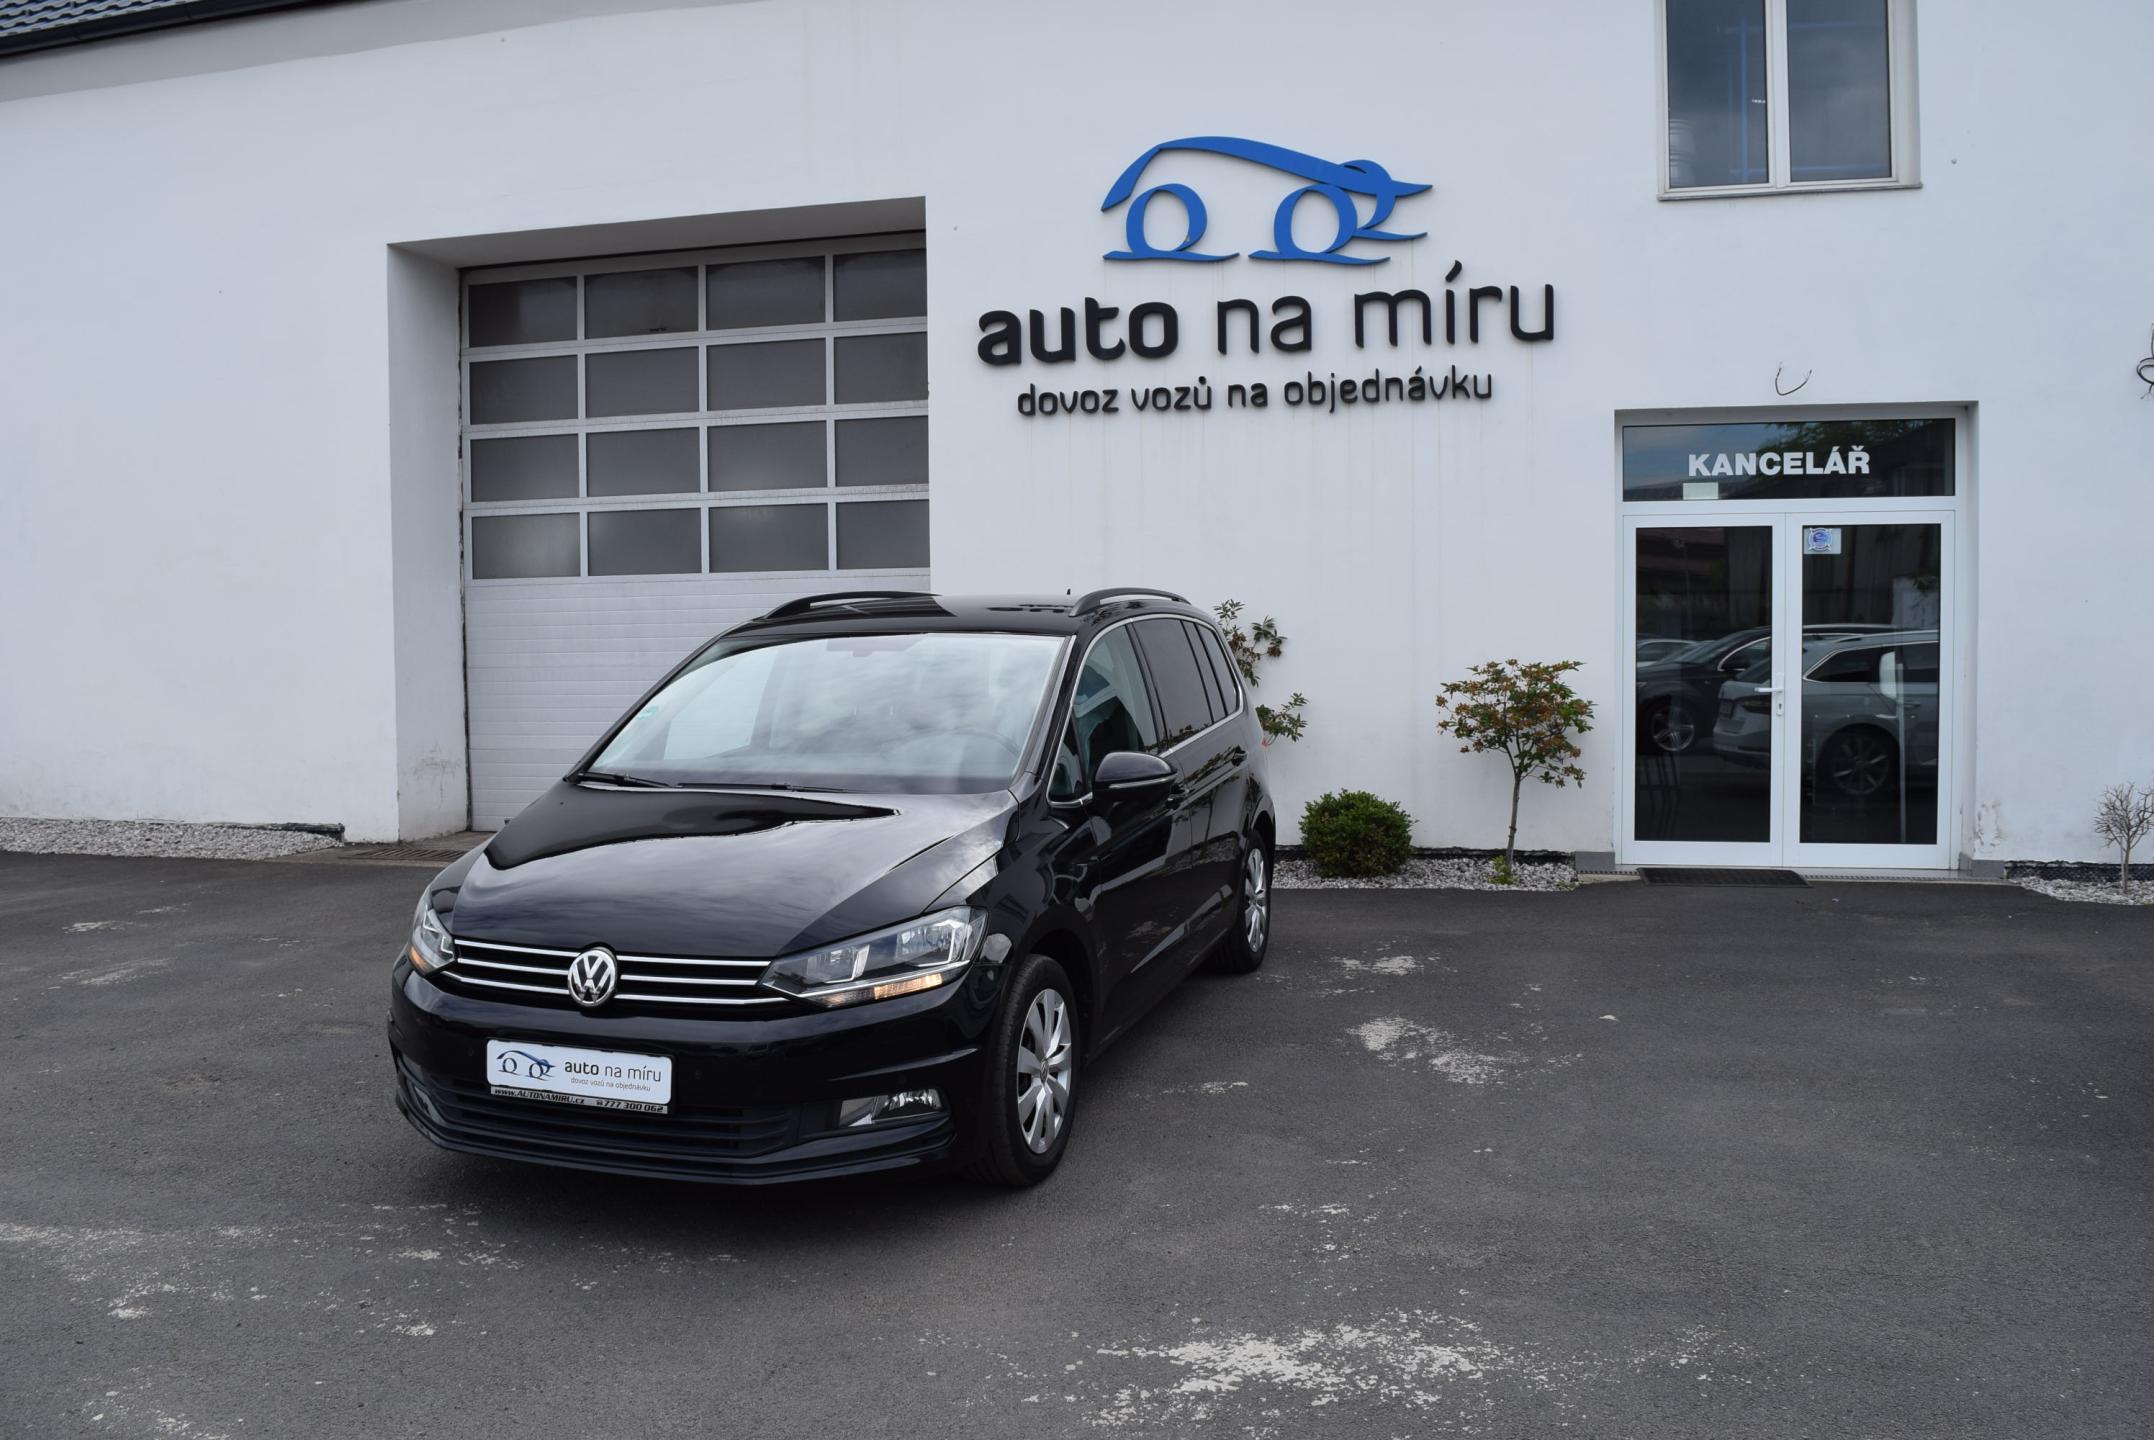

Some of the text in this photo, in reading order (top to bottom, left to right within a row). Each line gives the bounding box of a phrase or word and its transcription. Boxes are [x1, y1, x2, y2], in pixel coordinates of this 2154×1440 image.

[977, 259, 1555, 366] auto na míru
[1017, 364, 1493, 416] dovoz vozů na objednávku
[1688, 445, 1871, 477] KANCELÁŘ
[564, 1061, 662, 1082] auto na míru
[570, 1077, 589, 1085] dovoz
[603, 1100, 664, 1113] 777 300 062
